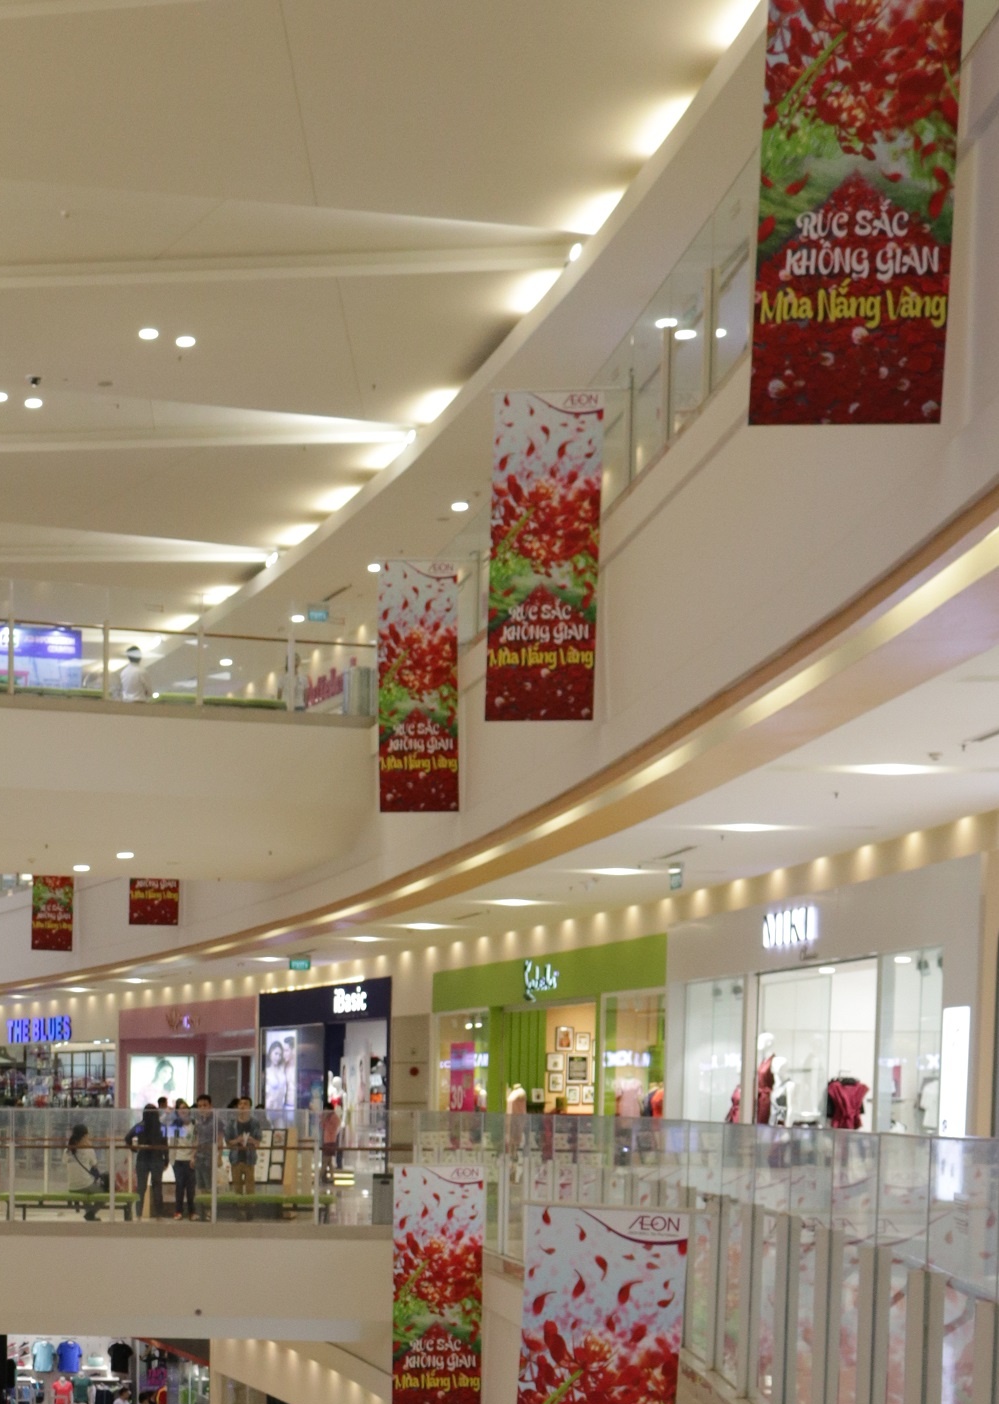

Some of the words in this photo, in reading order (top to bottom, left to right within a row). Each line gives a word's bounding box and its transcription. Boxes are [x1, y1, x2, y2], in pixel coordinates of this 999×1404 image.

[876, 246, 939, 283] GIAN
[6, 1017, 31, 1043] THE
[32, 1014, 72, 1042] BLUES
